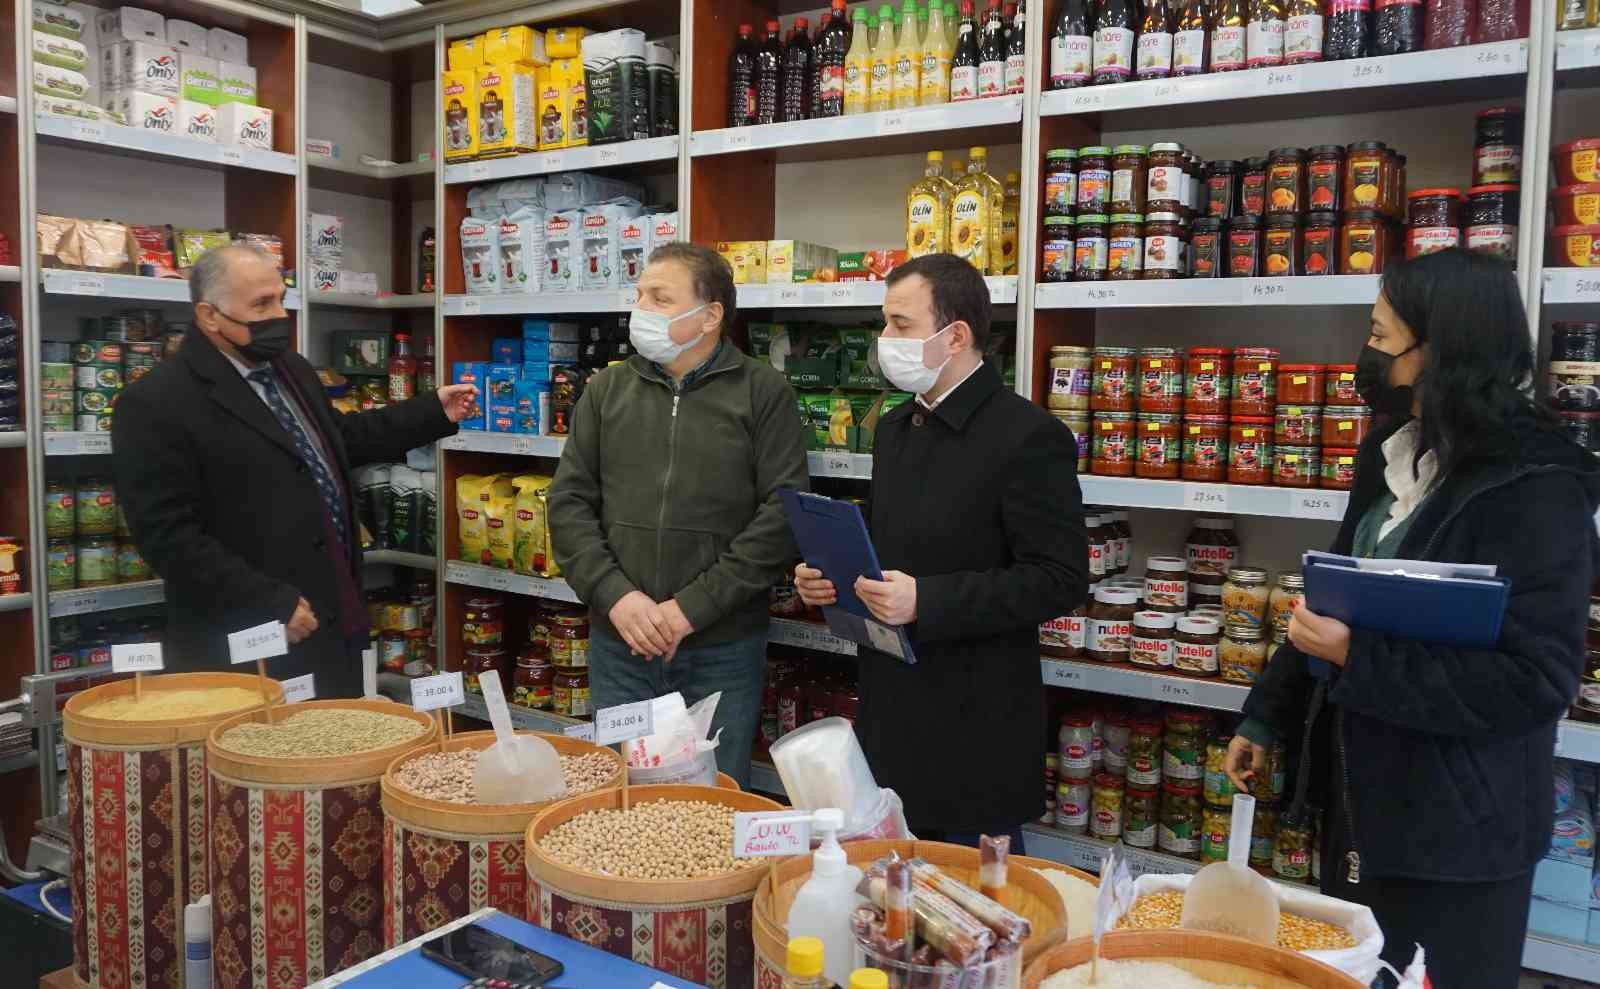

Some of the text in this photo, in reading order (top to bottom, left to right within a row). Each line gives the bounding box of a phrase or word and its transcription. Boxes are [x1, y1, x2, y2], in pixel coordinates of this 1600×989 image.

[146, 65, 175, 80] Only
[144, 117, 172, 131] Only
[188, 123, 214, 137] Only
[240, 127, 267, 141] Only
[912, 203, 931, 216] OLİN
[956, 200, 976, 213] OLİN
[1189, 547, 1234, 560] nutella
[1147, 582, 1184, 593] nutella
[1132, 640, 1168, 651] nutella
[1176, 645, 1212, 658] nutella
[610, 715, 636, 729] 34.00
